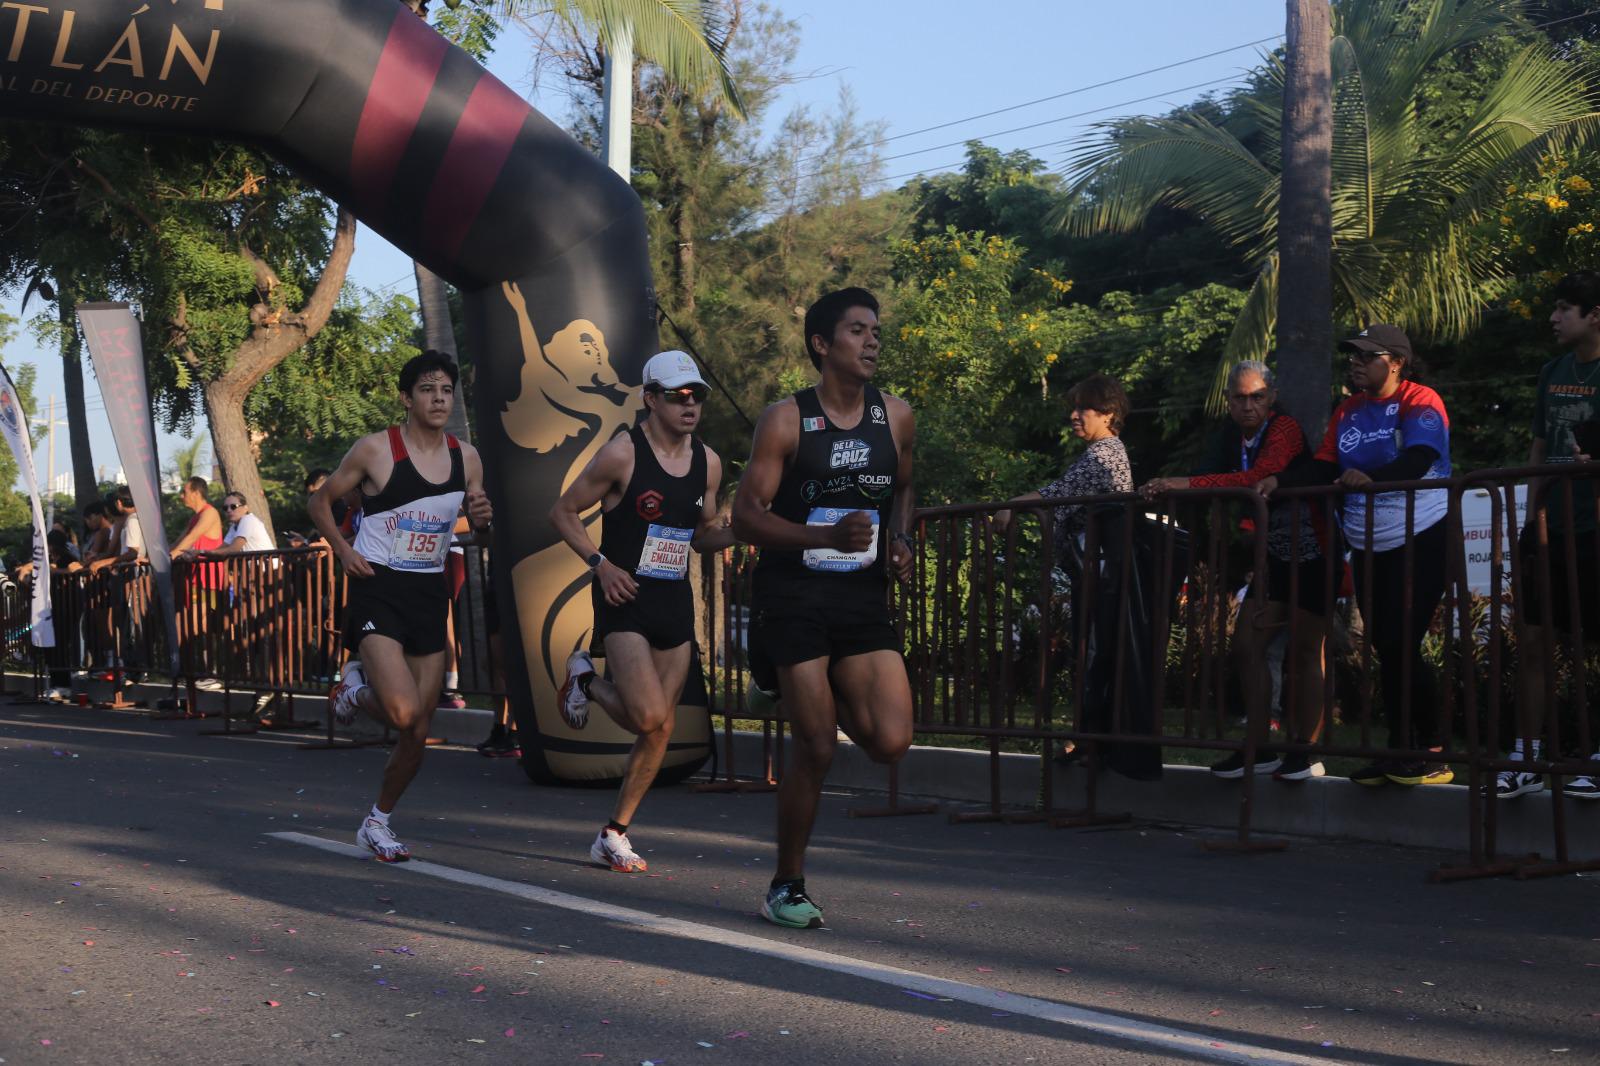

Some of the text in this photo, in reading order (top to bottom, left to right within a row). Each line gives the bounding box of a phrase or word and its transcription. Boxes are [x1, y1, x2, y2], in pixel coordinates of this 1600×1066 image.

[30, 79, 73, 98] DEL
[85, 85, 200, 112] DEPORTE
[834, 441, 844, 450] DE
[831, 448, 870, 467] CRUZ
[858, 474, 892, 485] SOLEDU
[407, 532, 438, 553] 135
